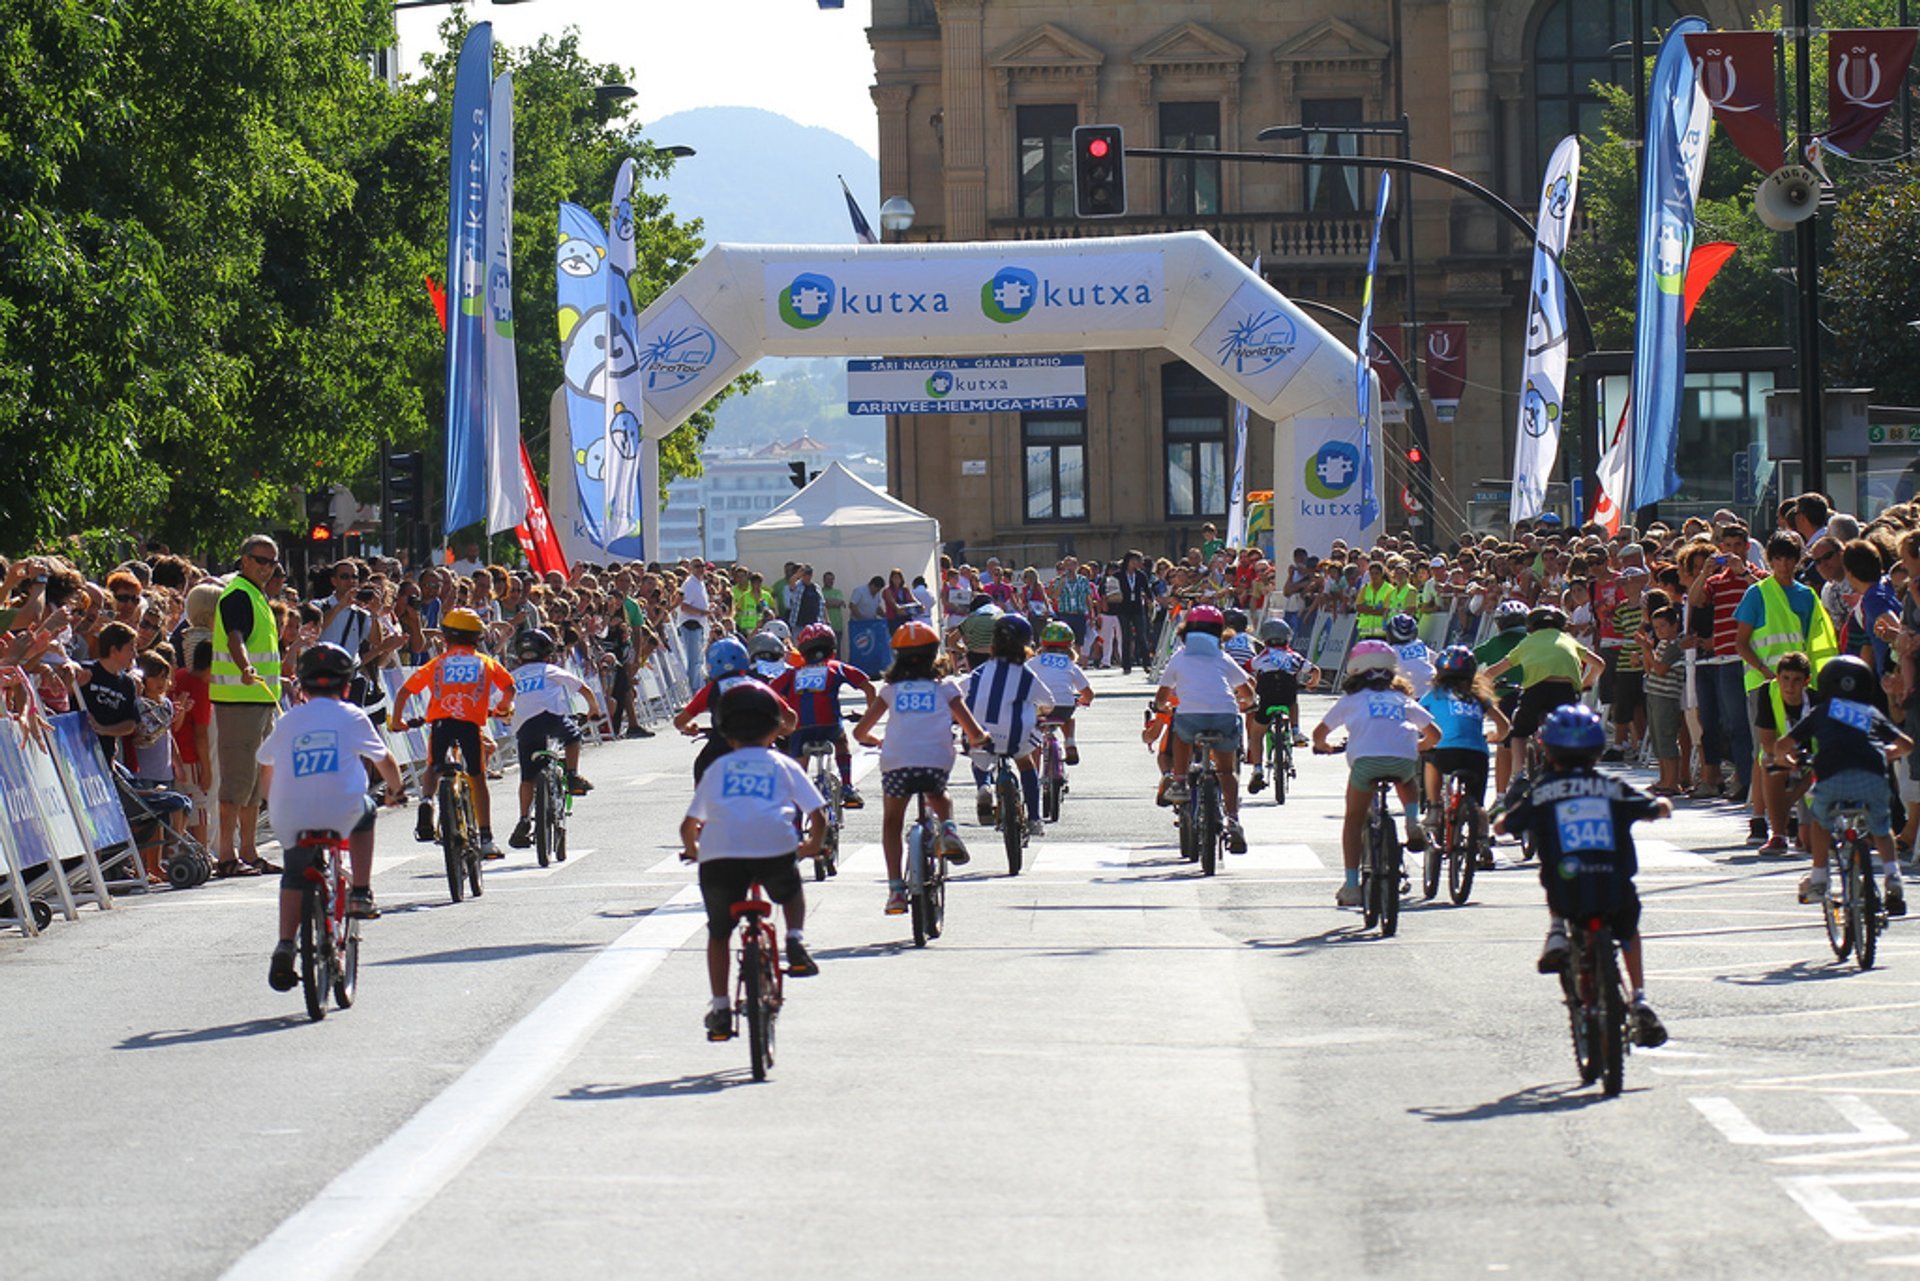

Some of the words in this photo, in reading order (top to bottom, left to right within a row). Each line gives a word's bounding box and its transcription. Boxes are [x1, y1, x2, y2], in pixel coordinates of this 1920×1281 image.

[465, 107, 484, 230] kutxa
[841, 287, 950, 314] kutxa
[1044, 279, 1153, 307] kutxa
[1248, 331, 1291, 347] UCI
[664, 349, 709, 364] UCI
[1233, 346, 1296, 358] WorldTour
[648, 363, 706, 373] ProTour
[870, 361, 898, 371] SARI
[903, 360, 959, 370] NAGUSIA
[975, 359, 1010, 369] GRAN
[1016, 357, 1061, 367] PREMIO
[955, 376, 1008, 391] kutxa
[856, 397, 1079, 414] ARRIVEE-HELMUGA-META
[1301, 499, 1361, 516] kutxa
[446, 666, 475, 683] 295
[897, 694, 933, 711] 384
[1831, 701, 1868, 731] 312
[296, 750, 336, 776] 277
[727, 775, 771, 797] 294
[1564, 821, 1611, 849] 344
